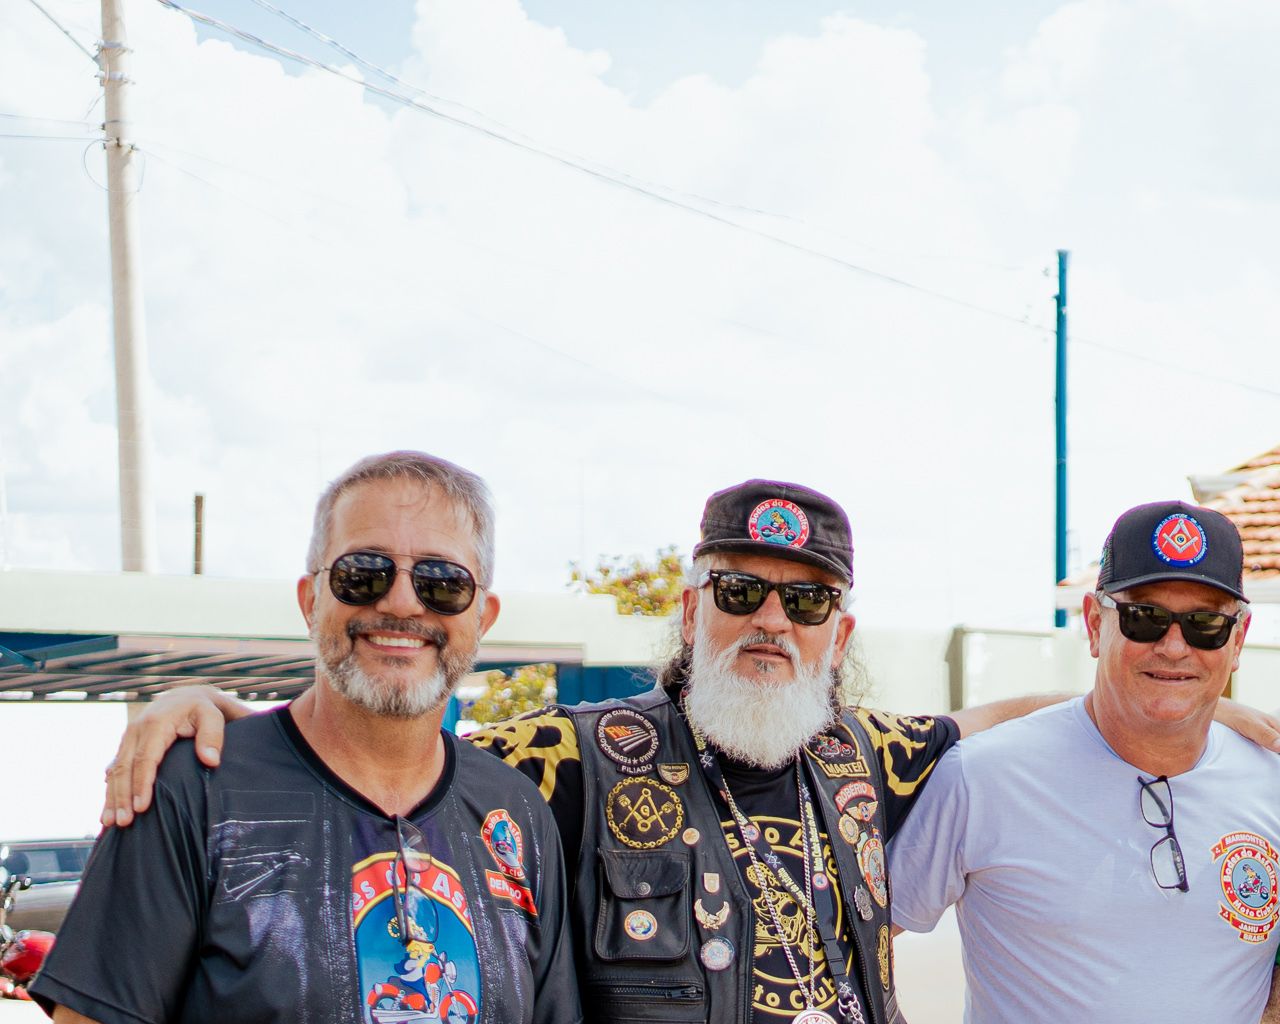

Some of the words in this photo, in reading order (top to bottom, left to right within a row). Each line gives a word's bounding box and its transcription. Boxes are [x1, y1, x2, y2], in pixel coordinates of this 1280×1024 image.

[621, 764, 653, 774] FILIADO
[825, 761, 865, 774] MASTER
[1223, 852, 1241, 882] Bodes
[1240, 847, 1253, 857] do
[1254, 851, 1276, 886] Asfalto
[1233, 899, 1255, 918] Moto
[1256, 902, 1275, 918] Clube
[1239, 922, 1259, 933] JAHU
